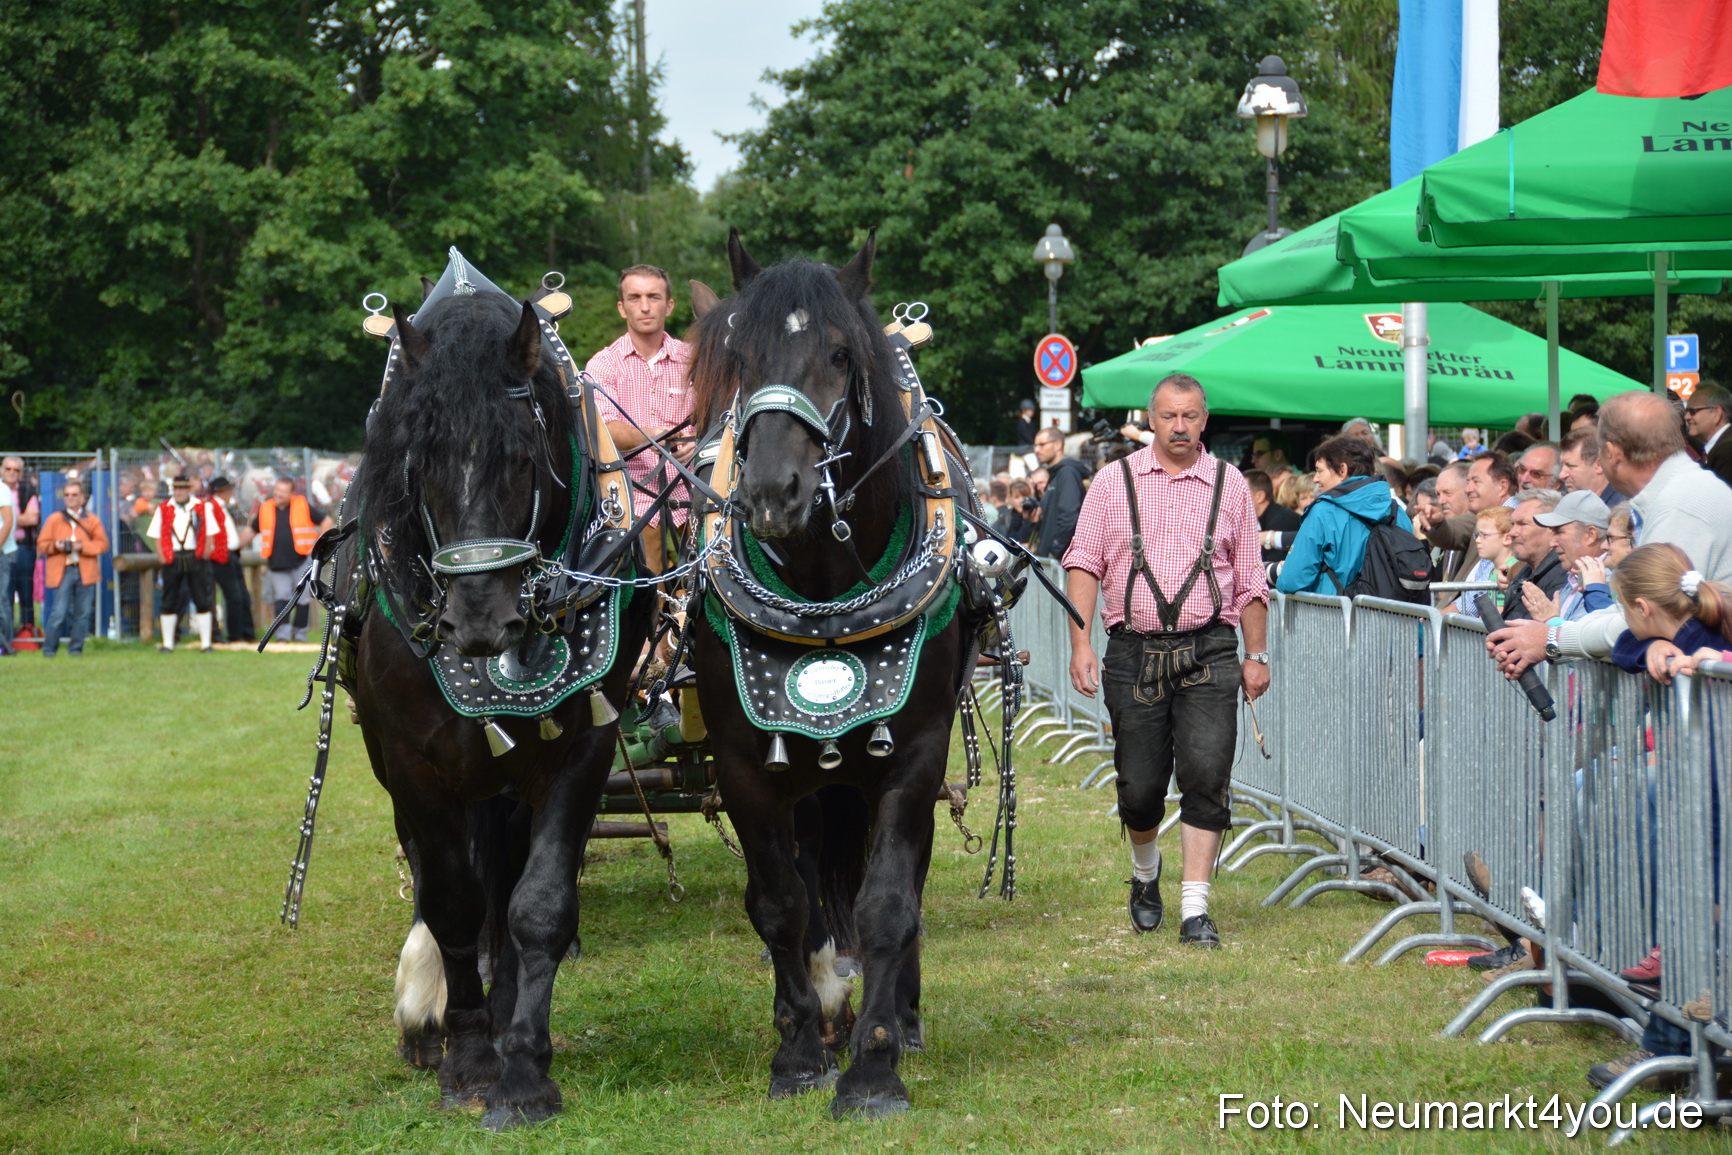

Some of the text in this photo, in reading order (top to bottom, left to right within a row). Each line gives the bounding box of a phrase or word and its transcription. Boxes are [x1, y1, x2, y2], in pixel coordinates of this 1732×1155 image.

[1337, 345, 1482, 365] Neumrkter
[1669, 339, 1690, 369] P
[1669, 377, 1693, 396] P2
